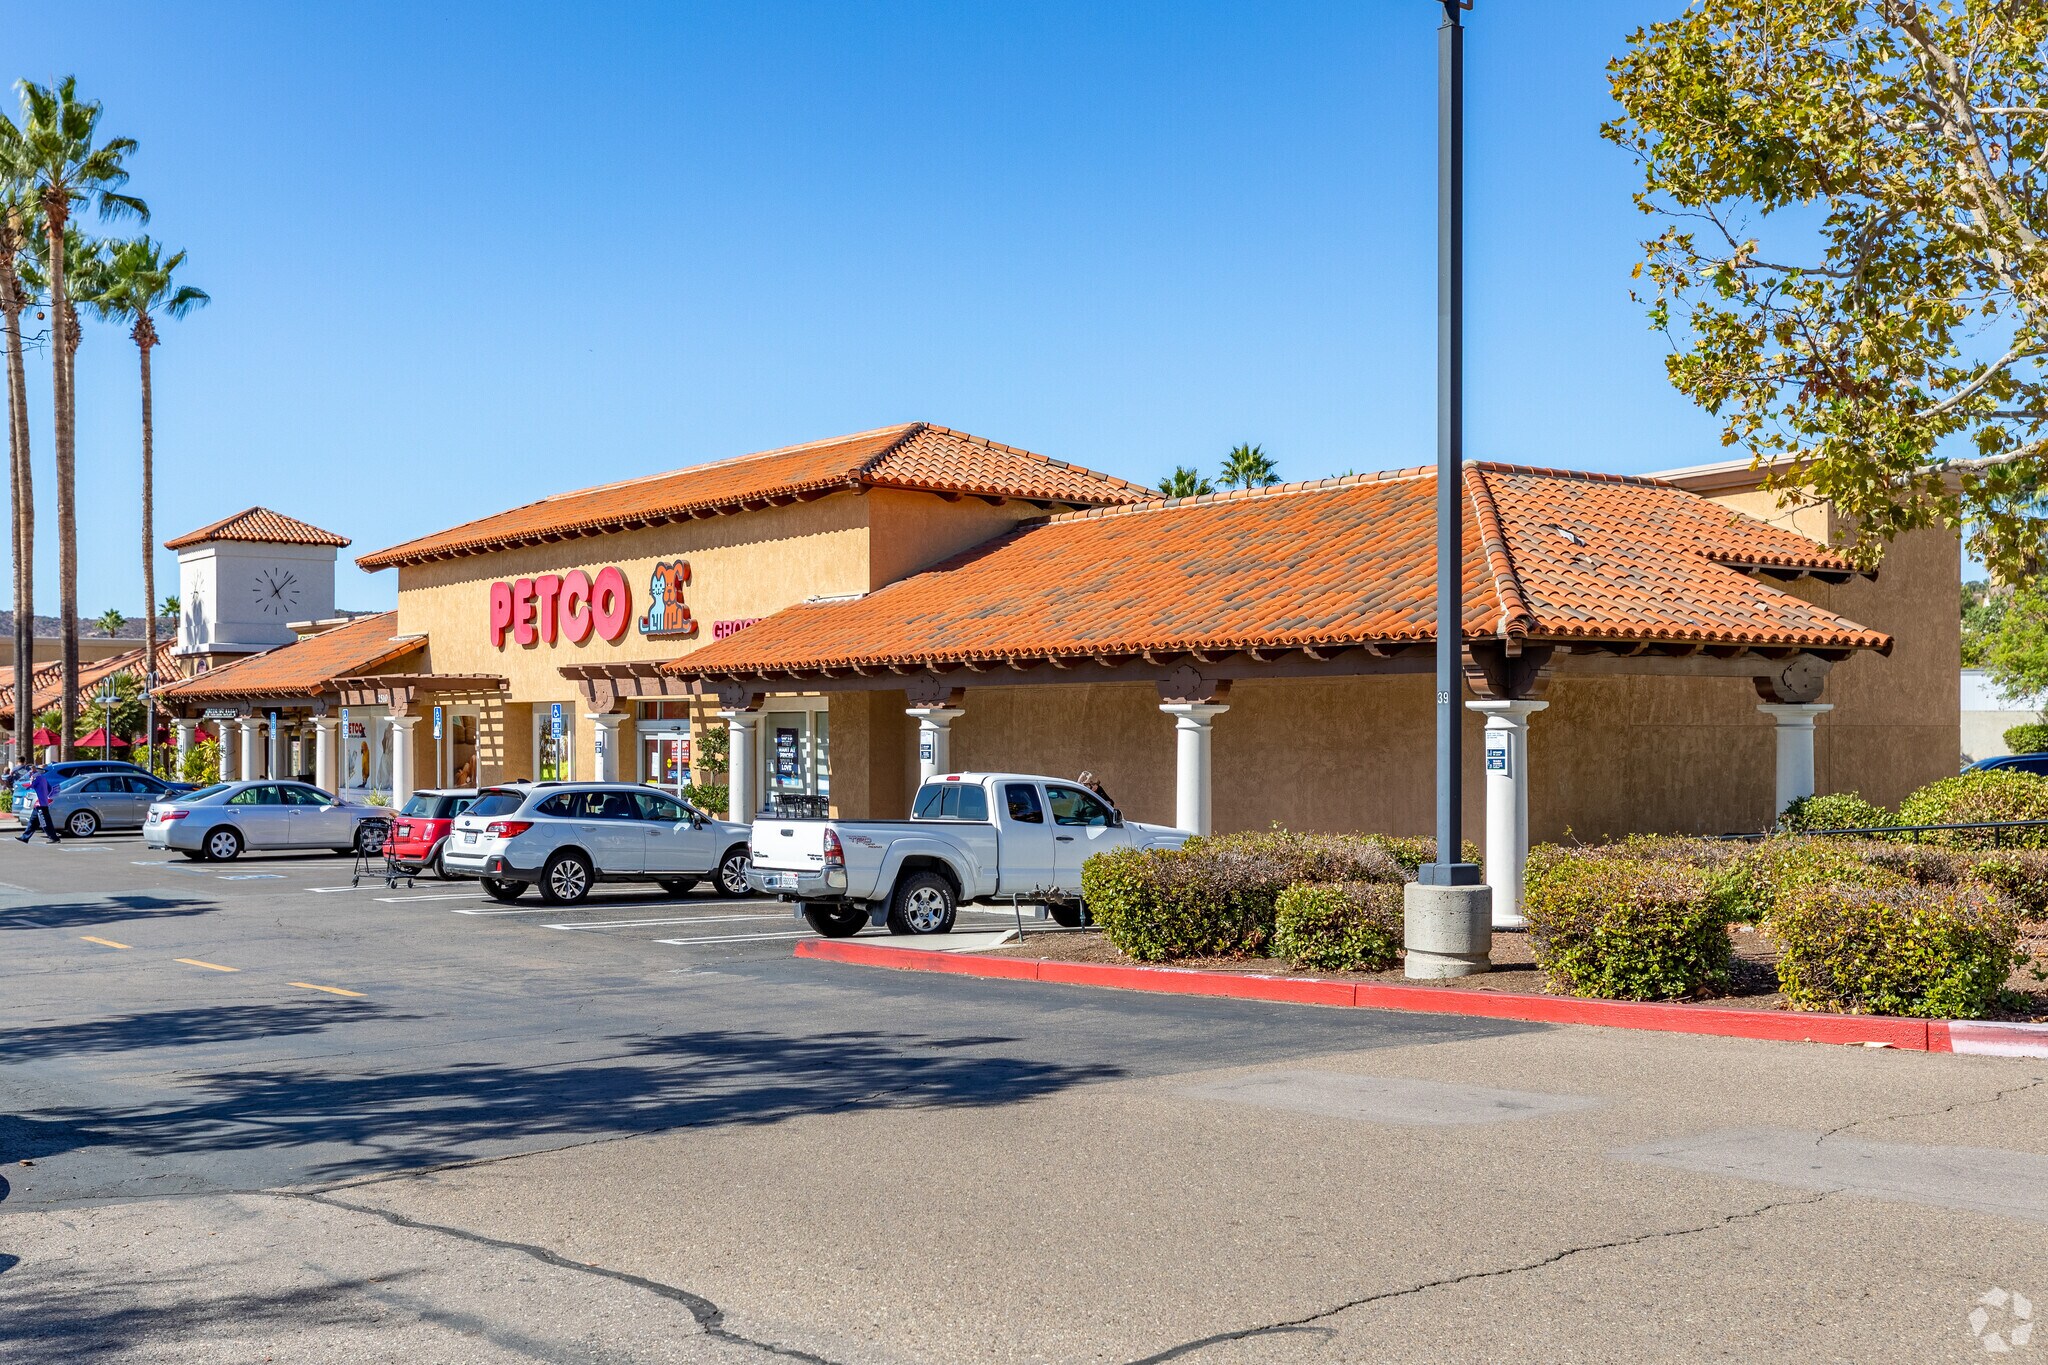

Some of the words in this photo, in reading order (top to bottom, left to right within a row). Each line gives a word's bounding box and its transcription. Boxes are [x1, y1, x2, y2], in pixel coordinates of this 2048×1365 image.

[490, 566, 632, 647] PETCO
[713, 618, 766, 641] GRO
[1437, 691, 1449, 704] 39
[348, 722, 364, 734] ETCO
